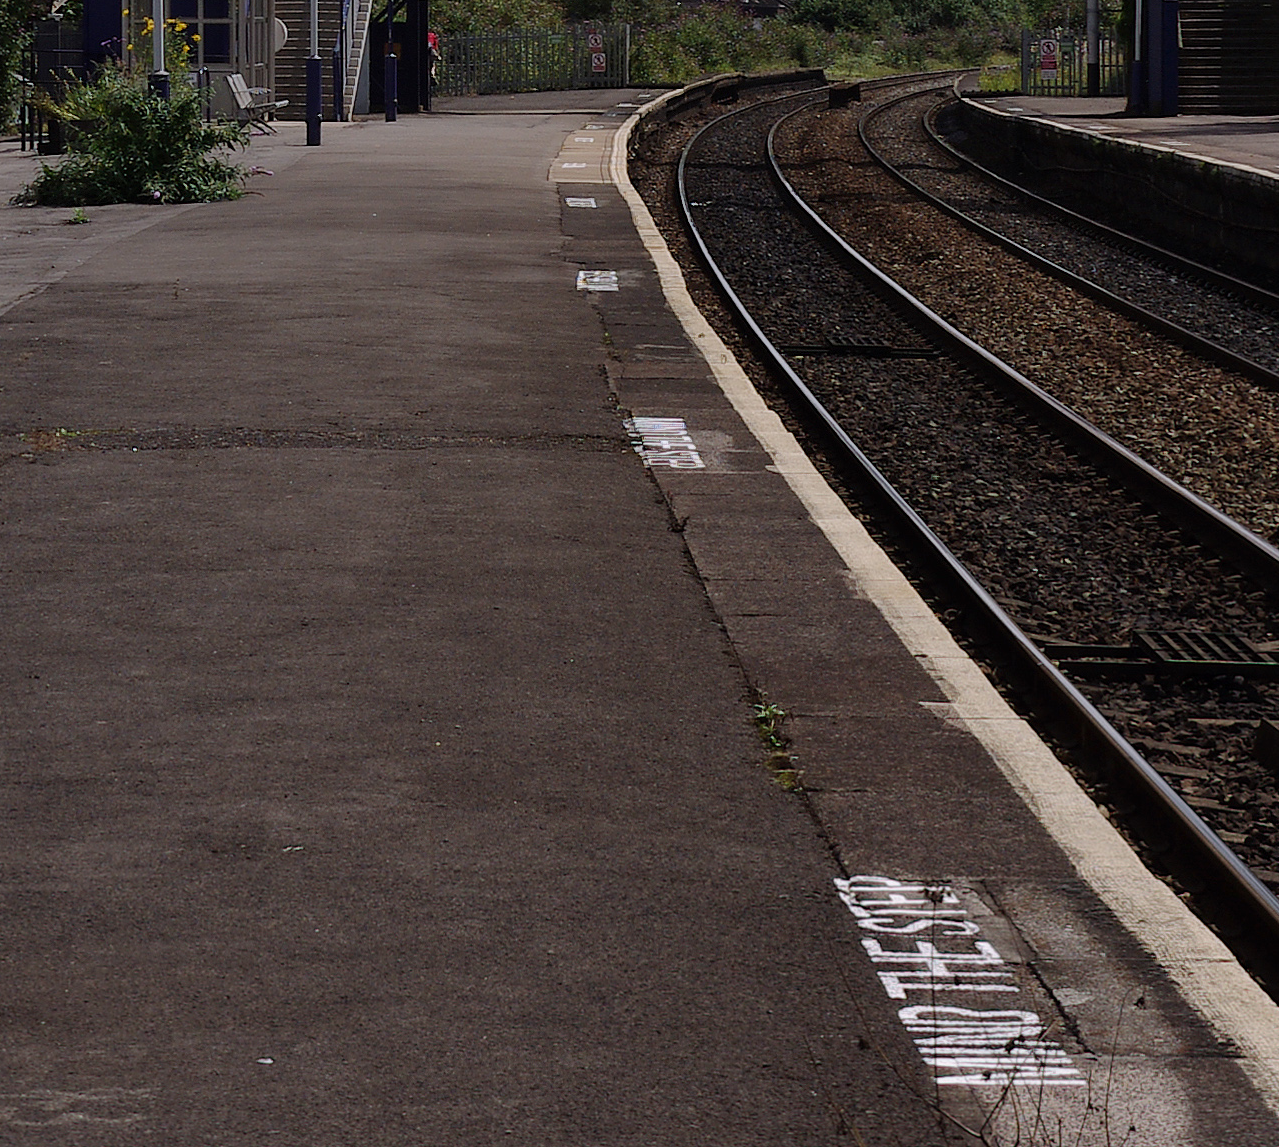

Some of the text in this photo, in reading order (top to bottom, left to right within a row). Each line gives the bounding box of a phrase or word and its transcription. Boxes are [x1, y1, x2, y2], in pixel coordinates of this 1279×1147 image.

[833, 875, 1088, 1085] MIND THE STEP
